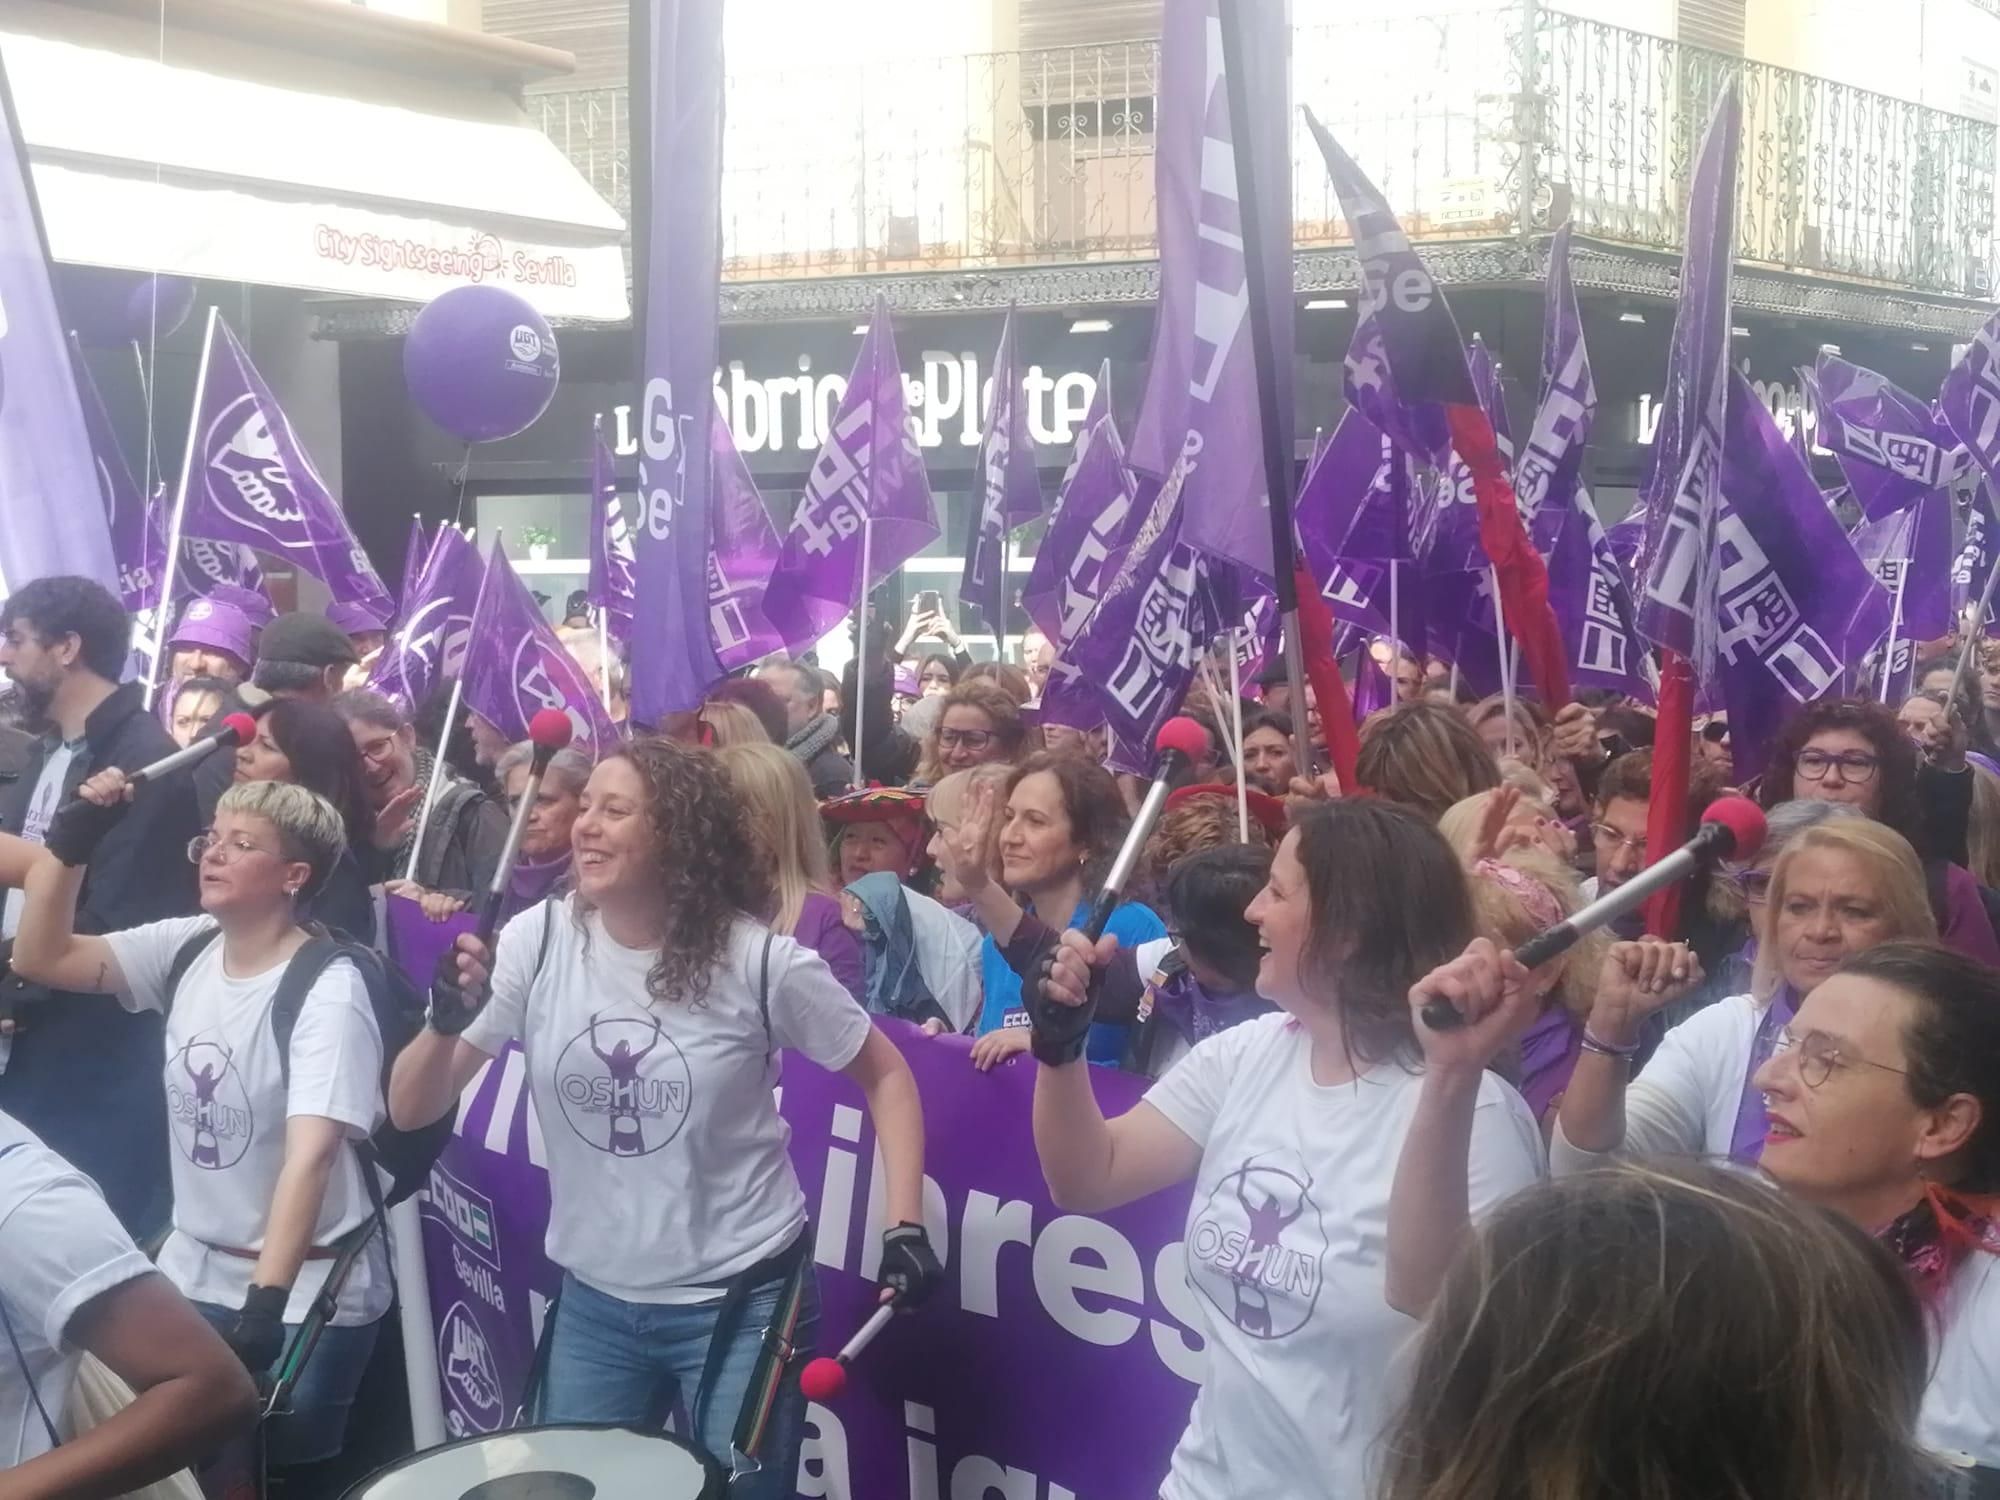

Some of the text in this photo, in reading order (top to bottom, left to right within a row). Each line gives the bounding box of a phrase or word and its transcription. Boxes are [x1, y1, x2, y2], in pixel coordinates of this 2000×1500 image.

[314, 223, 577, 288] City Sightseeing Sevilla
[166, 1083, 247, 1138] OSHUN
[561, 1073, 685, 1113] OSHUN
[453, 1243, 506, 1314] Sevilla
[1193, 1219, 1315, 1298] OSHUN
